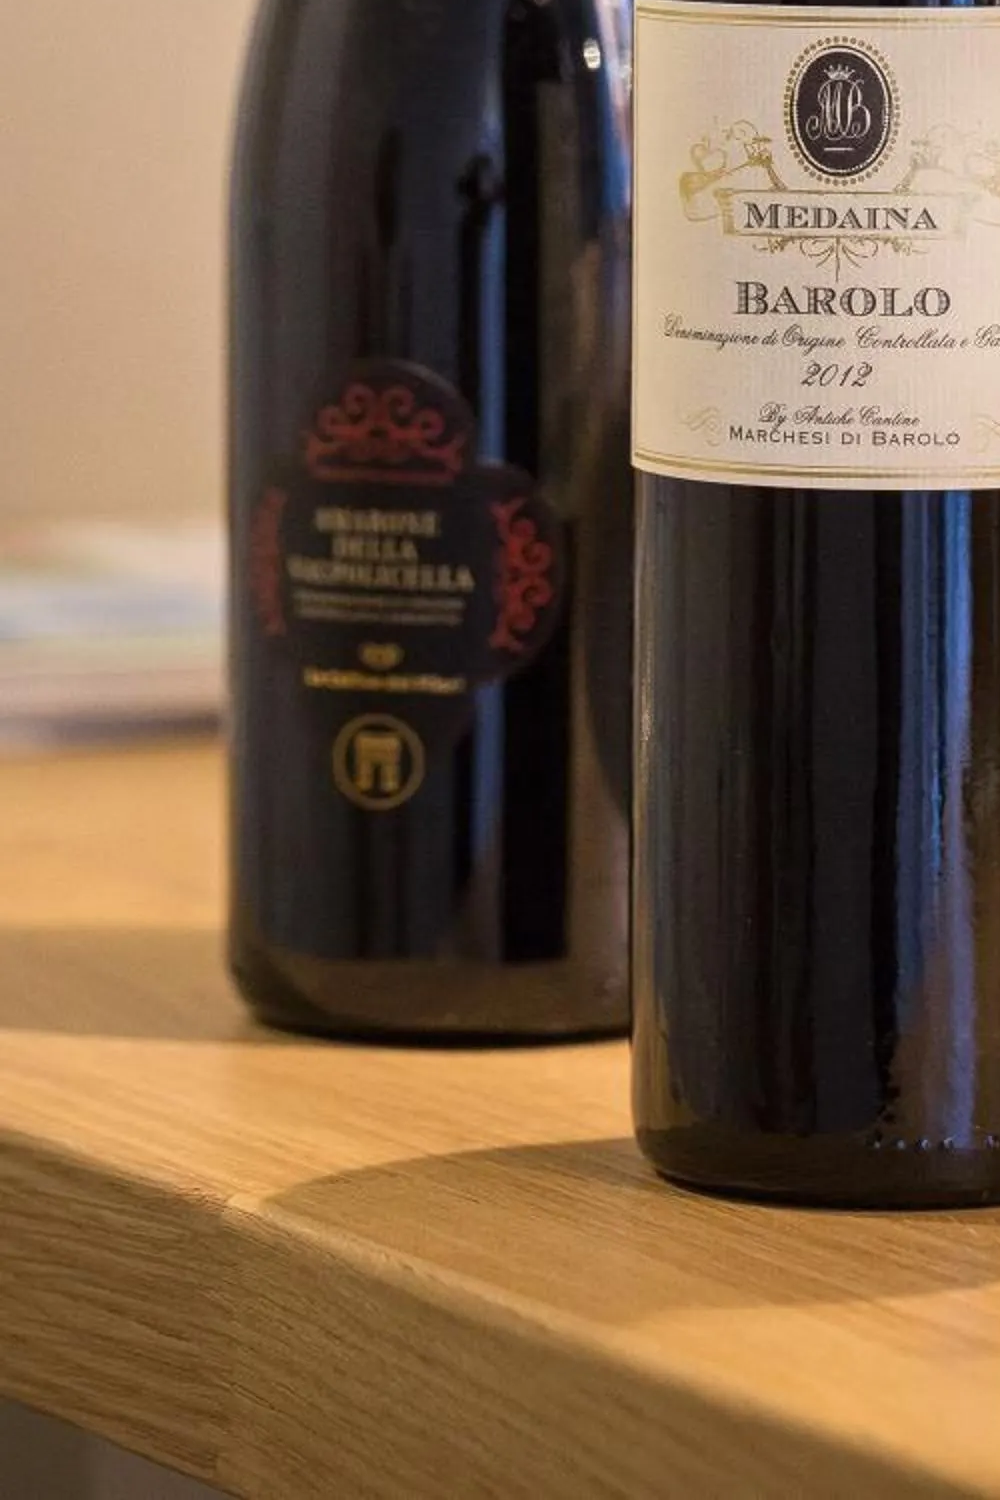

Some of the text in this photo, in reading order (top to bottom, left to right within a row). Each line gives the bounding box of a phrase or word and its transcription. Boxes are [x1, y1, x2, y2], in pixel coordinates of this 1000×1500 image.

[743, 202, 938, 230] MEDAINA
[733, 281, 951, 317] BAROLO
[761, 328, 779, 346] di
[782, 323, 846, 357] Origine
[855, 325, 956, 350] Controllata
[959, 337, 970, 349] e
[801, 360, 874, 388] 2012
[758, 401, 921, 432] By Antiche Cantine
[729, 425, 961, 447] MARCHESI DI BAROLO
